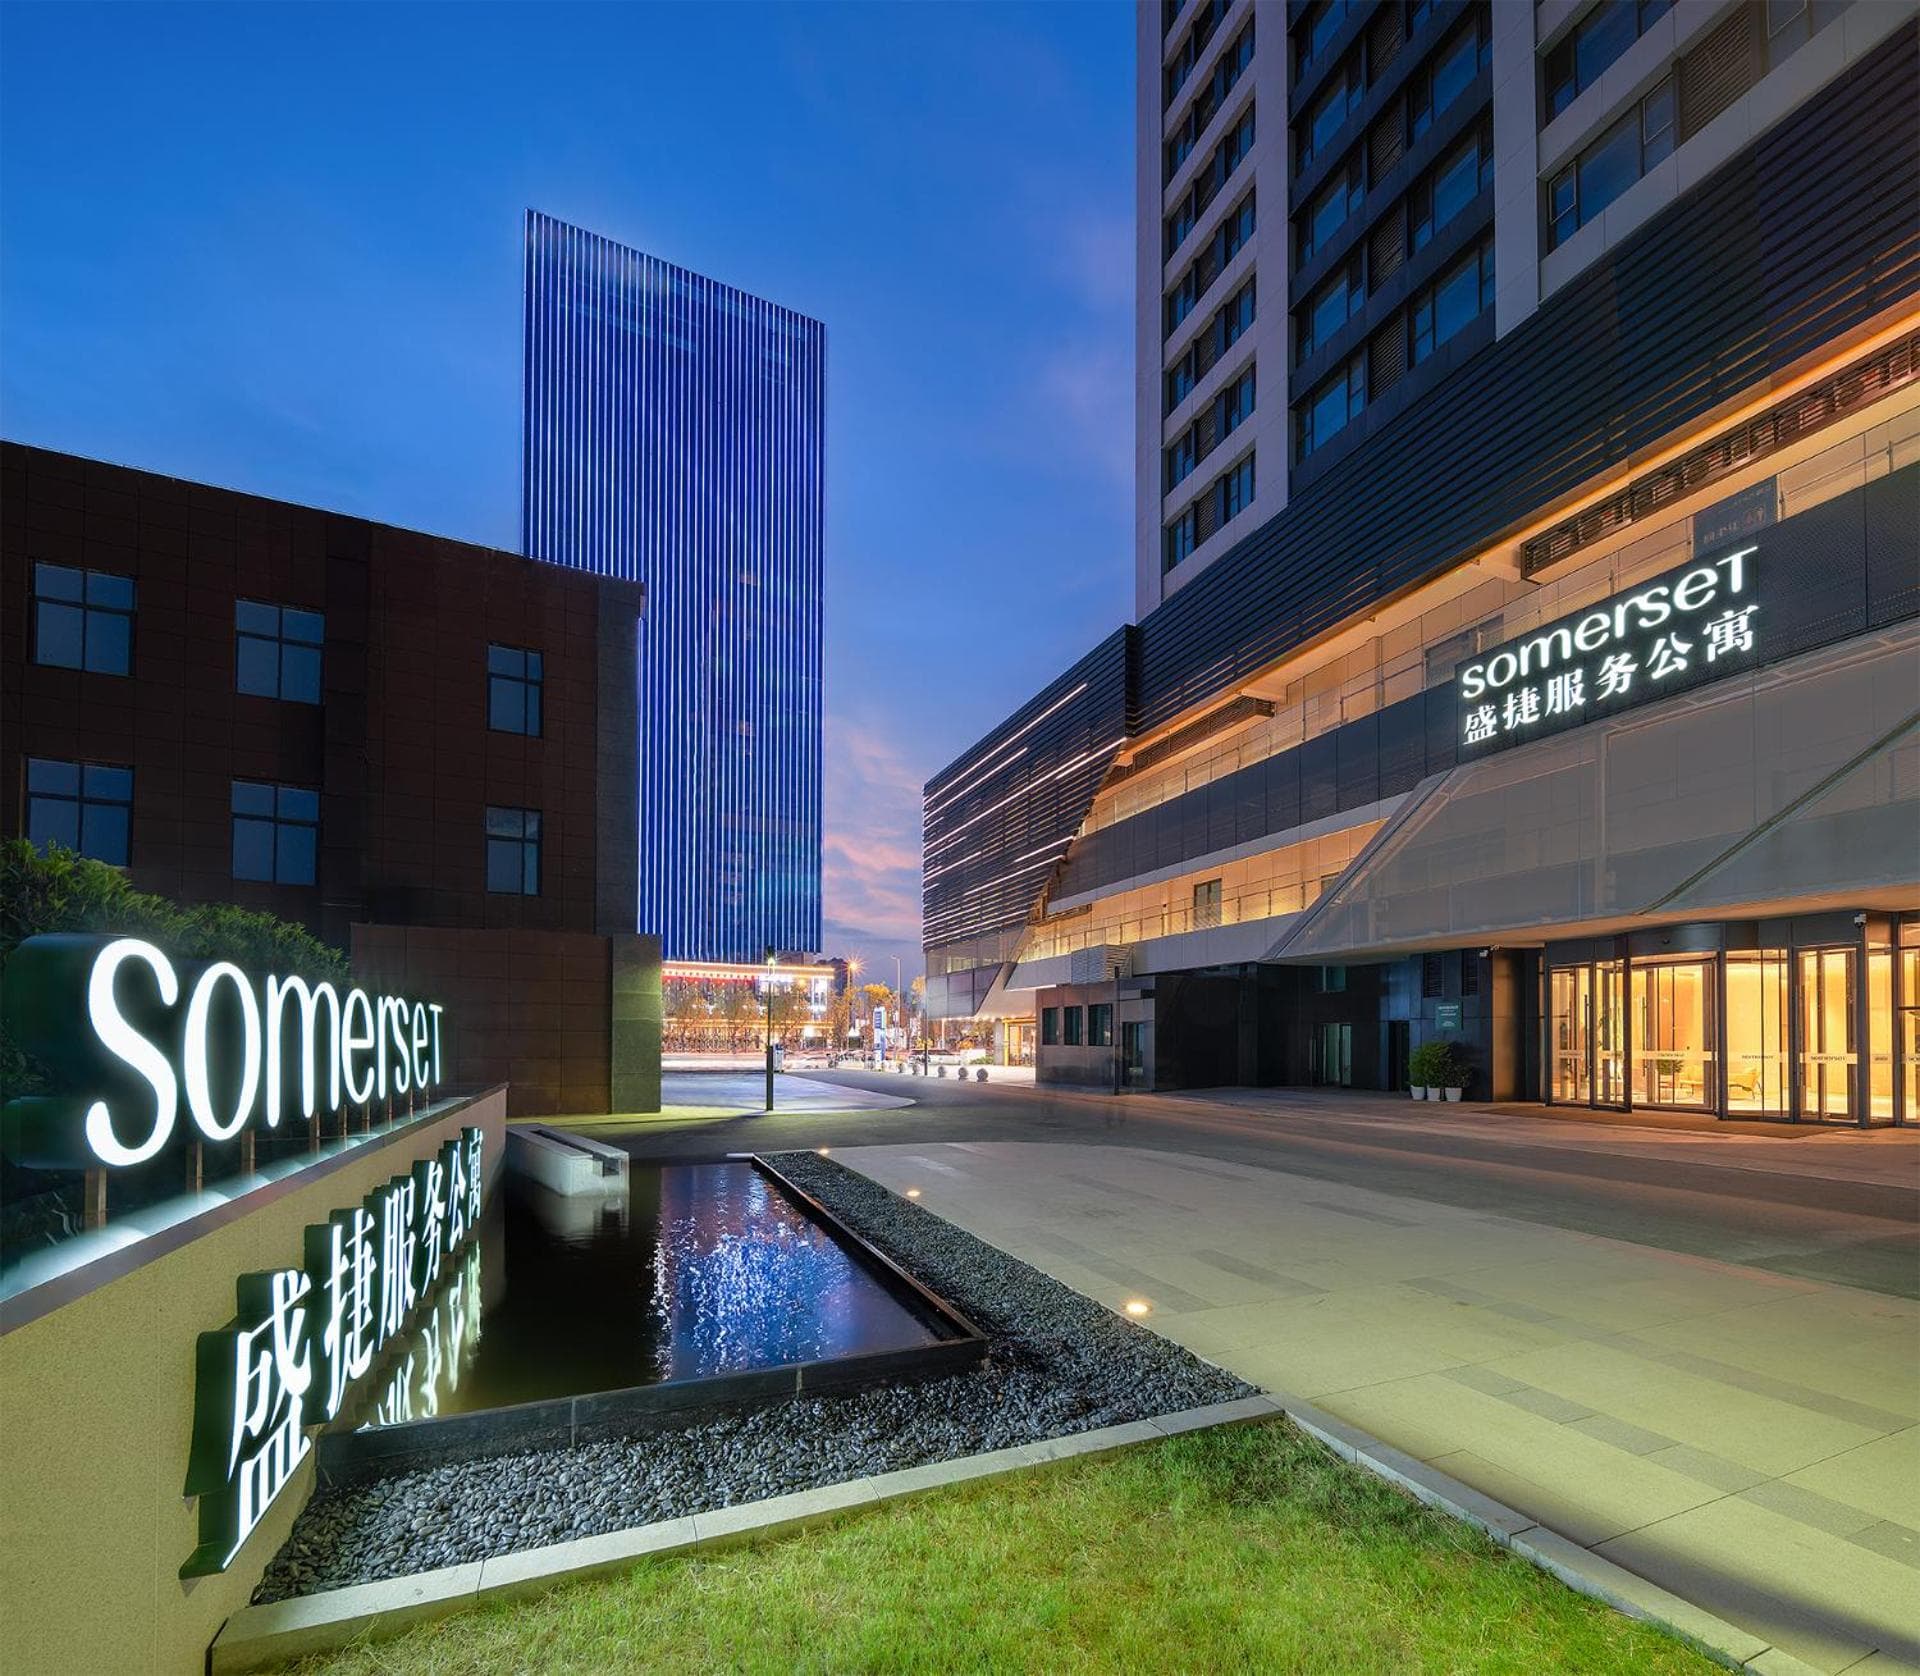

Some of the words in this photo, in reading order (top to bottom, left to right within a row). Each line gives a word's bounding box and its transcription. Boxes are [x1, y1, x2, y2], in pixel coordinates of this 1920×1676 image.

[1463, 604, 1760, 746] 盛捷服务公寓
[222, 1128, 484, 1570] 盛捷服务公寓
